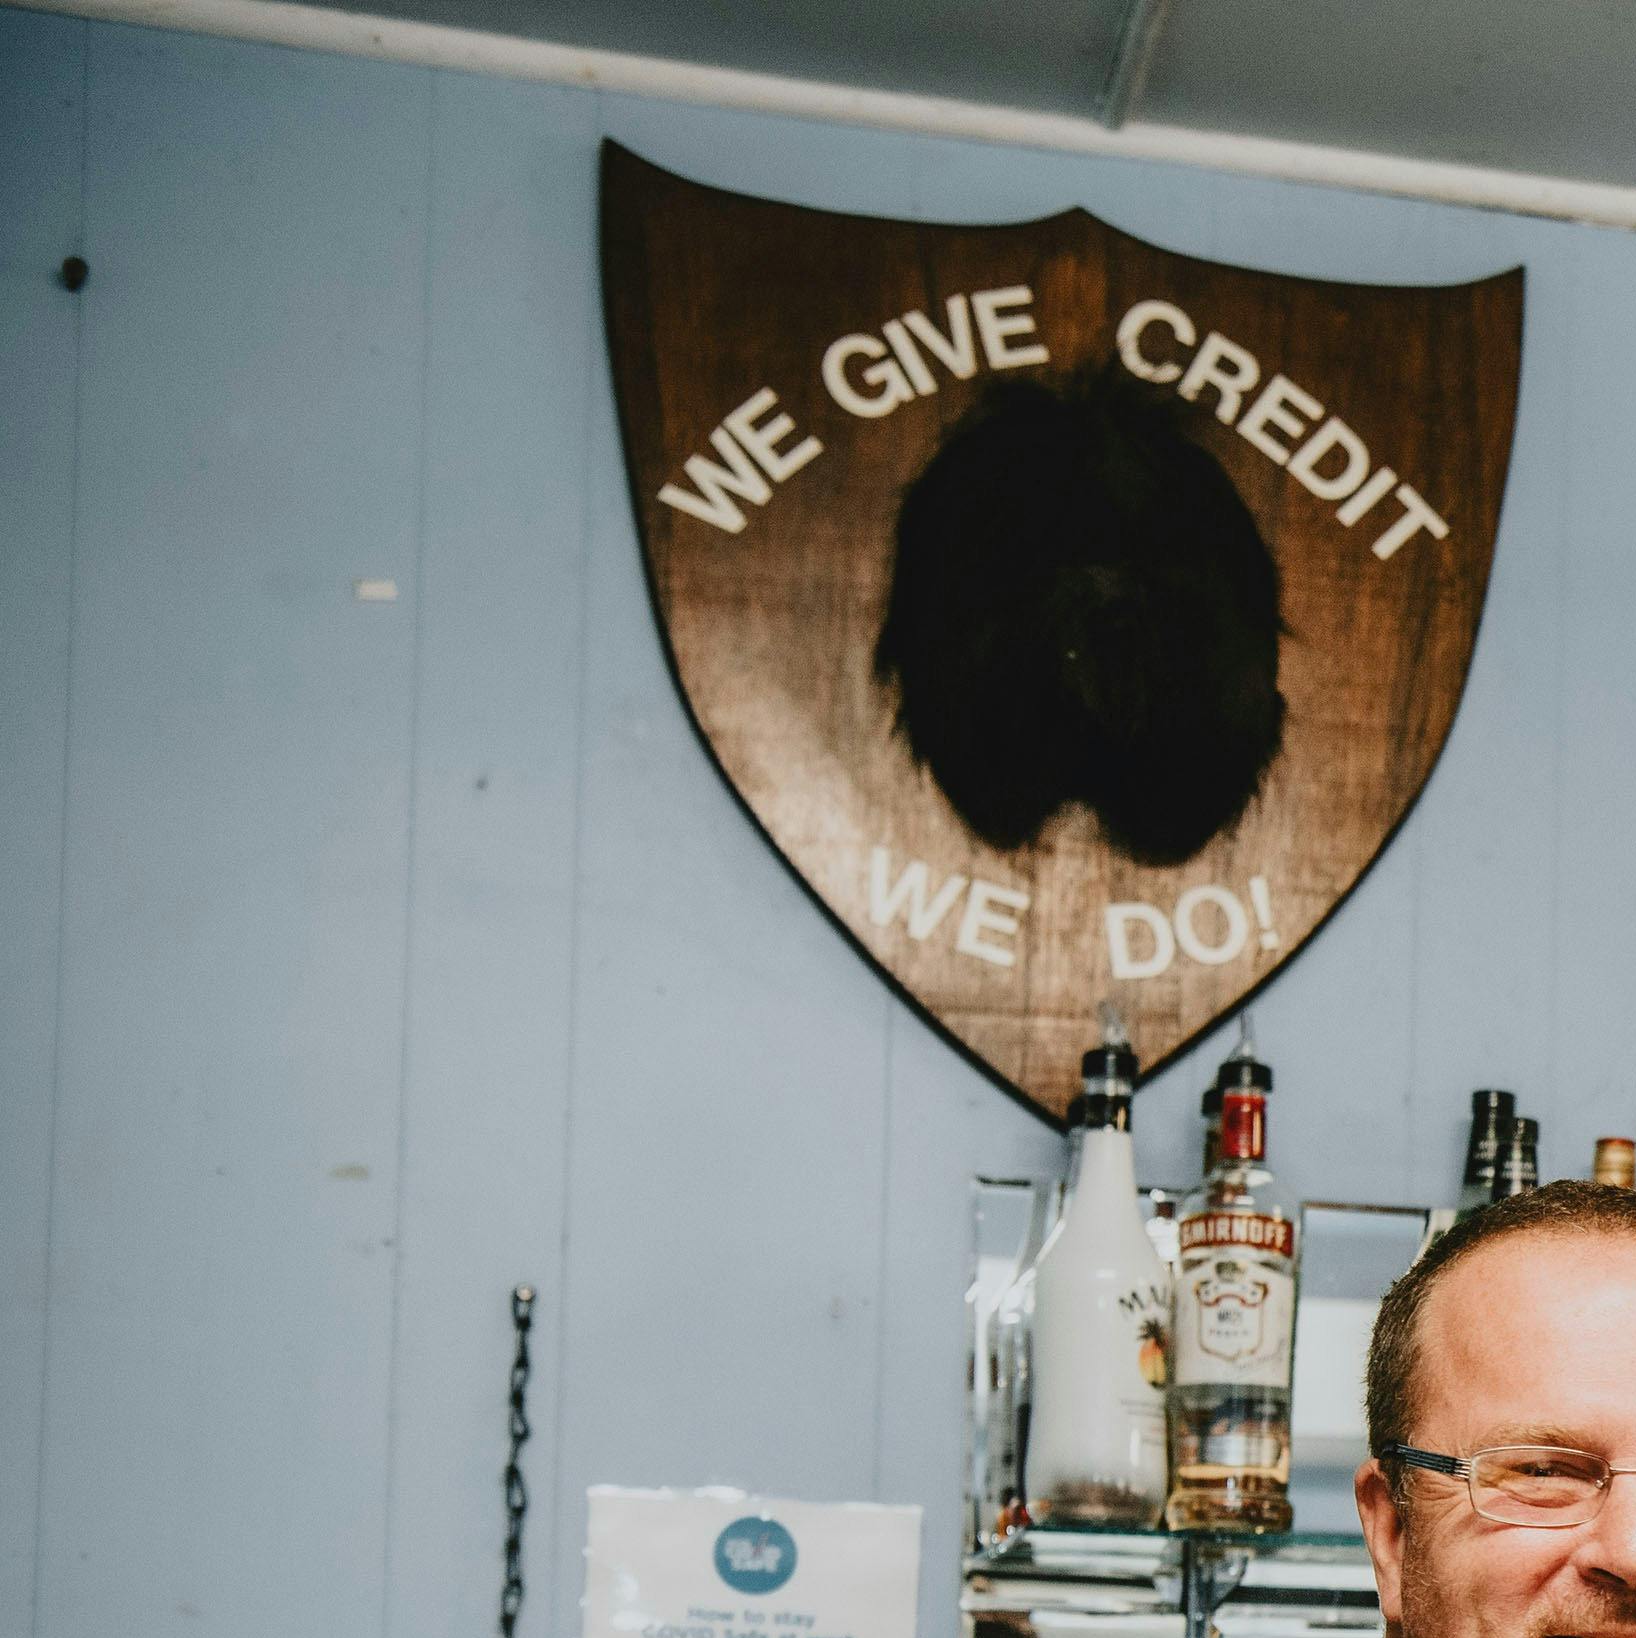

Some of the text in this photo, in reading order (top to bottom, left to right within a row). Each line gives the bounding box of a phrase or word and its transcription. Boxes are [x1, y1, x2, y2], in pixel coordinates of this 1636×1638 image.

[658, 285, 1451, 561] WE GIVE CREDIT
[865, 846, 1280, 980] WE DO!
